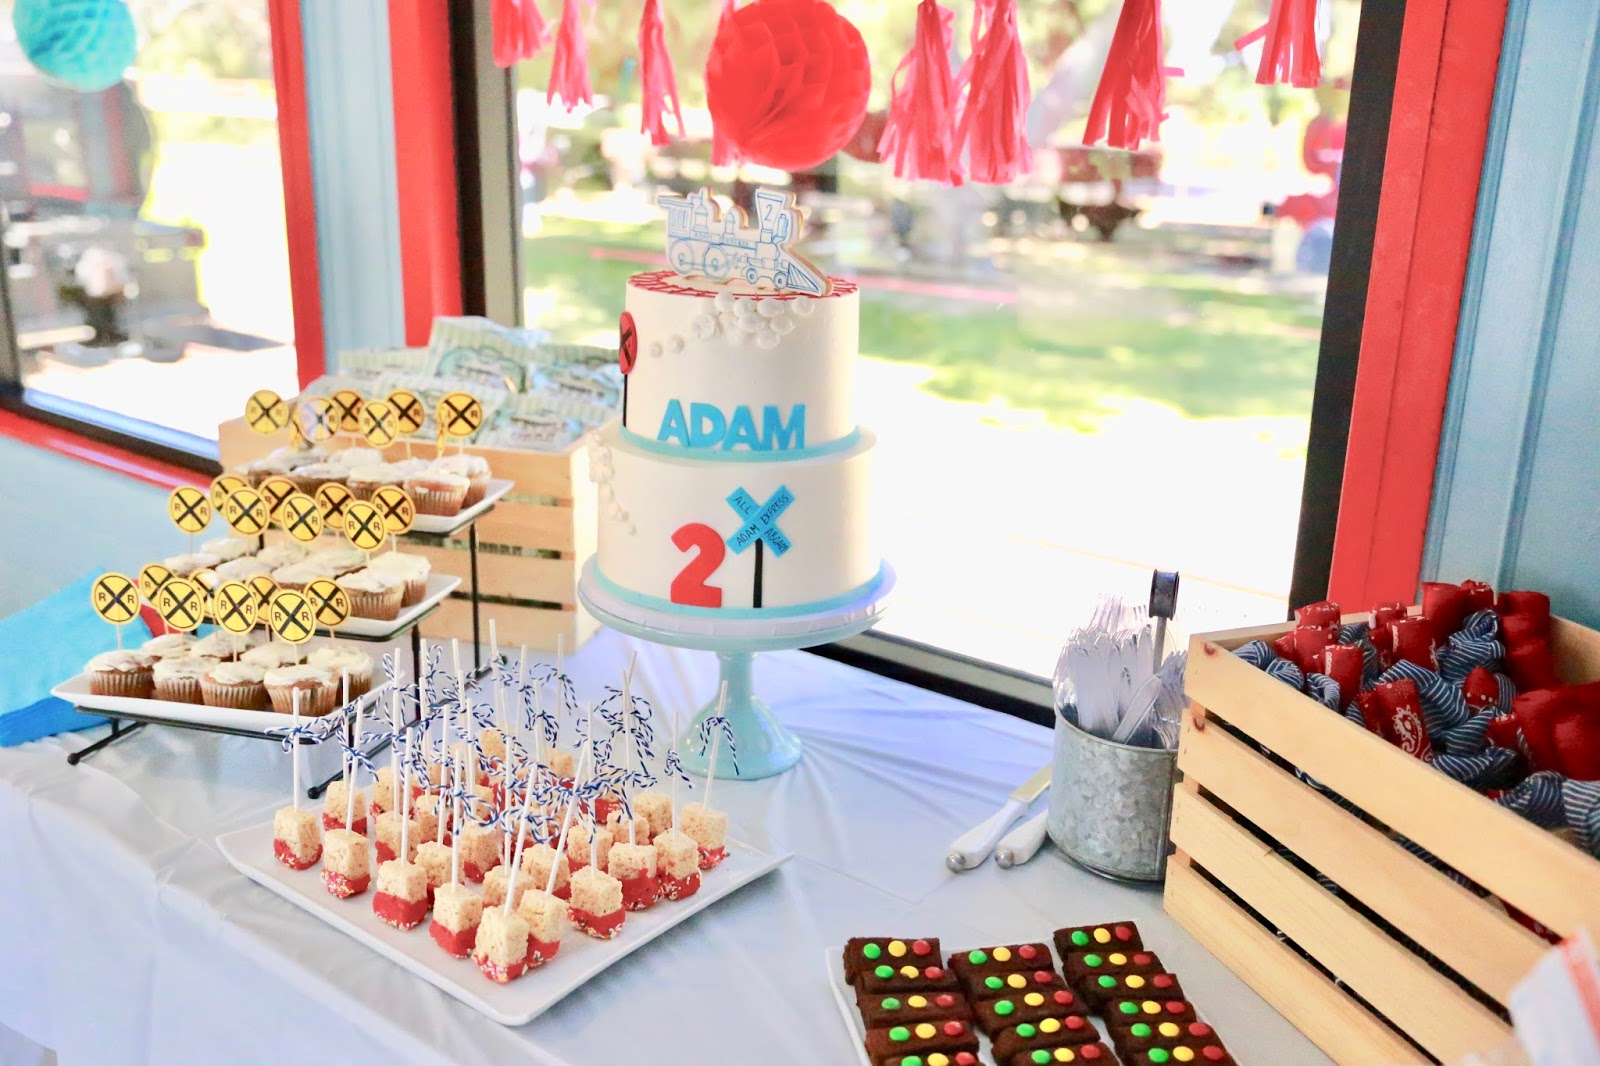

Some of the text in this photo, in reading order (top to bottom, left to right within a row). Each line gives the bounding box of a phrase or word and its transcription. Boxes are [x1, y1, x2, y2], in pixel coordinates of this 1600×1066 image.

[764, 204, 772, 222] 2
[657, 398, 806, 451] ADAM
[732, 496, 751, 515] ALL
[736, 494, 789, 547] ADAM EXPRESS
[670, 522, 727, 608] 2
